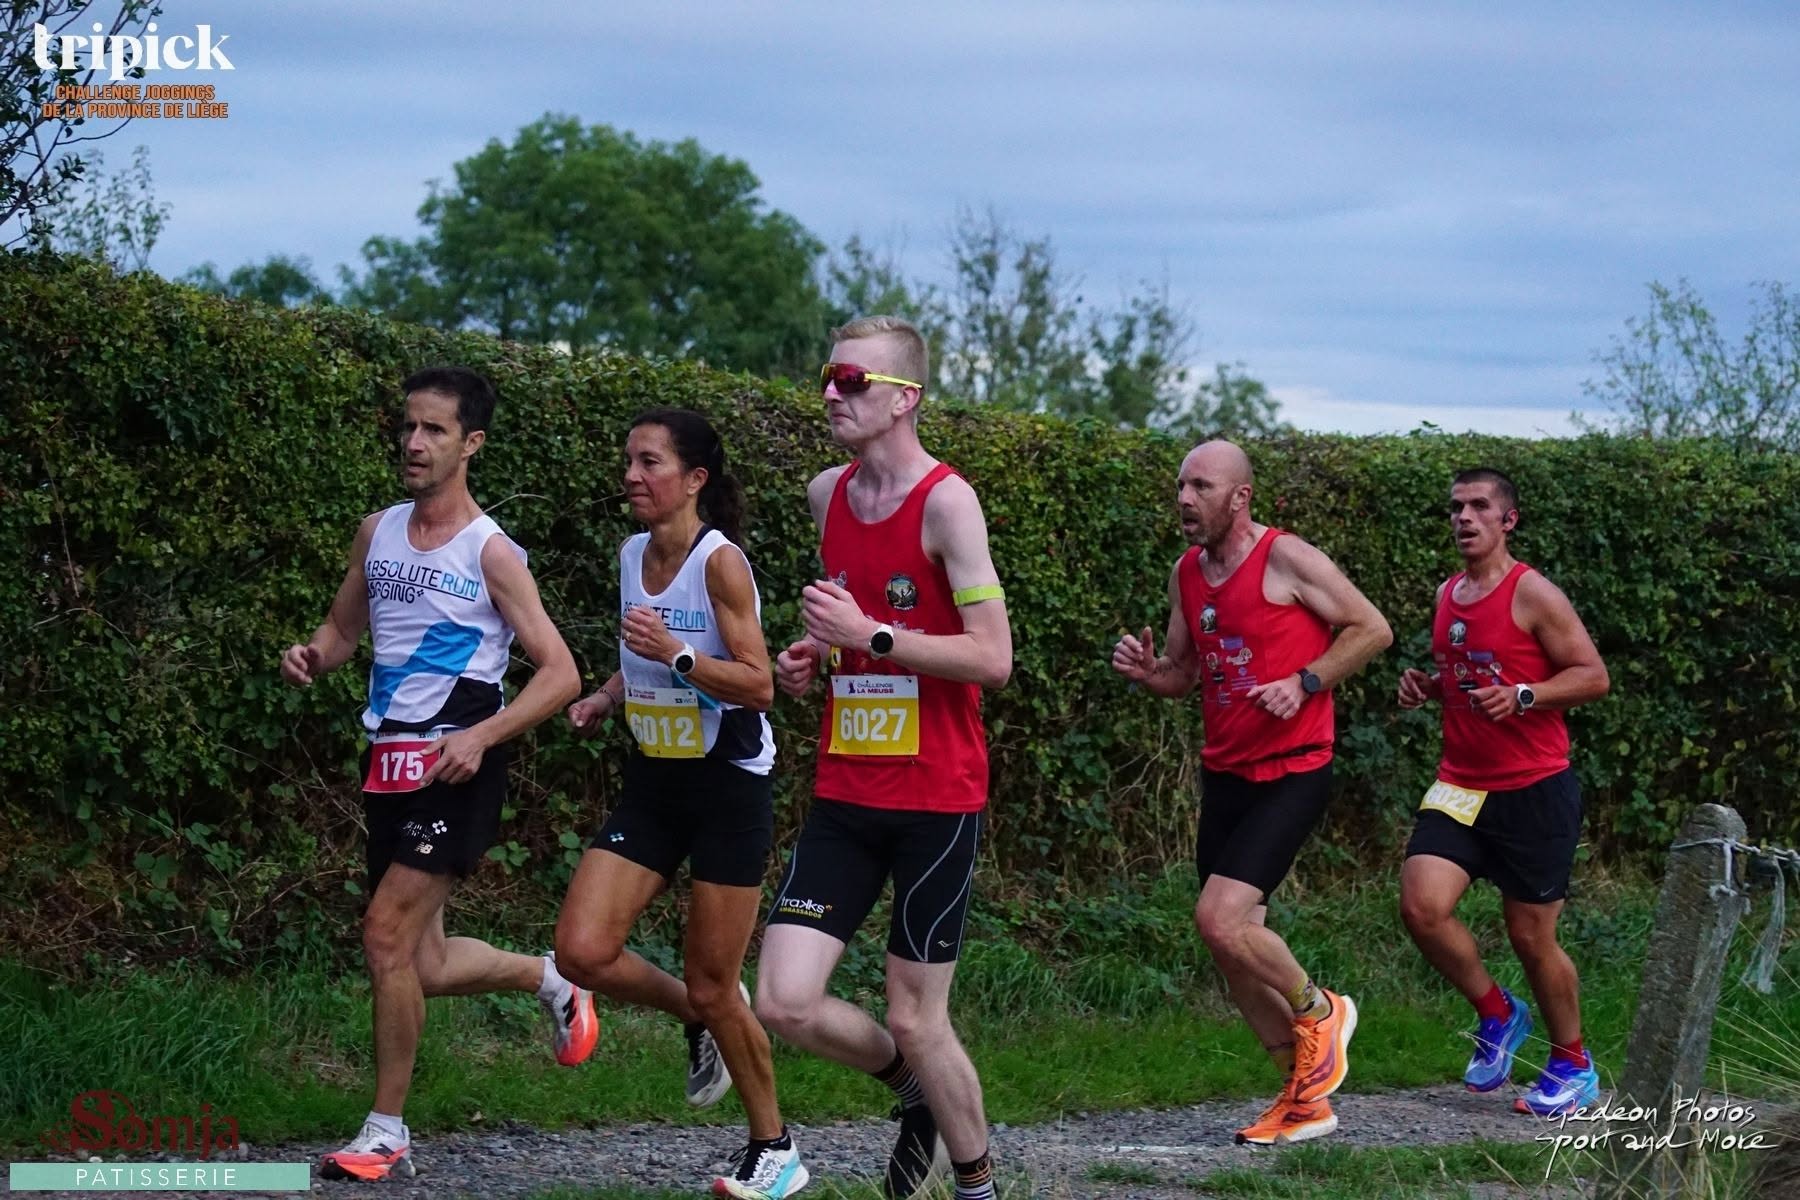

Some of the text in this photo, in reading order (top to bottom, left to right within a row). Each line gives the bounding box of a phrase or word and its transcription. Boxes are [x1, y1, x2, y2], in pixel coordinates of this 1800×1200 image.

[672, 608, 707, 629] RUN
[629, 711, 697, 747] 6012
[840, 707, 908, 742] 6027
[380, 750, 424, 782] 175
